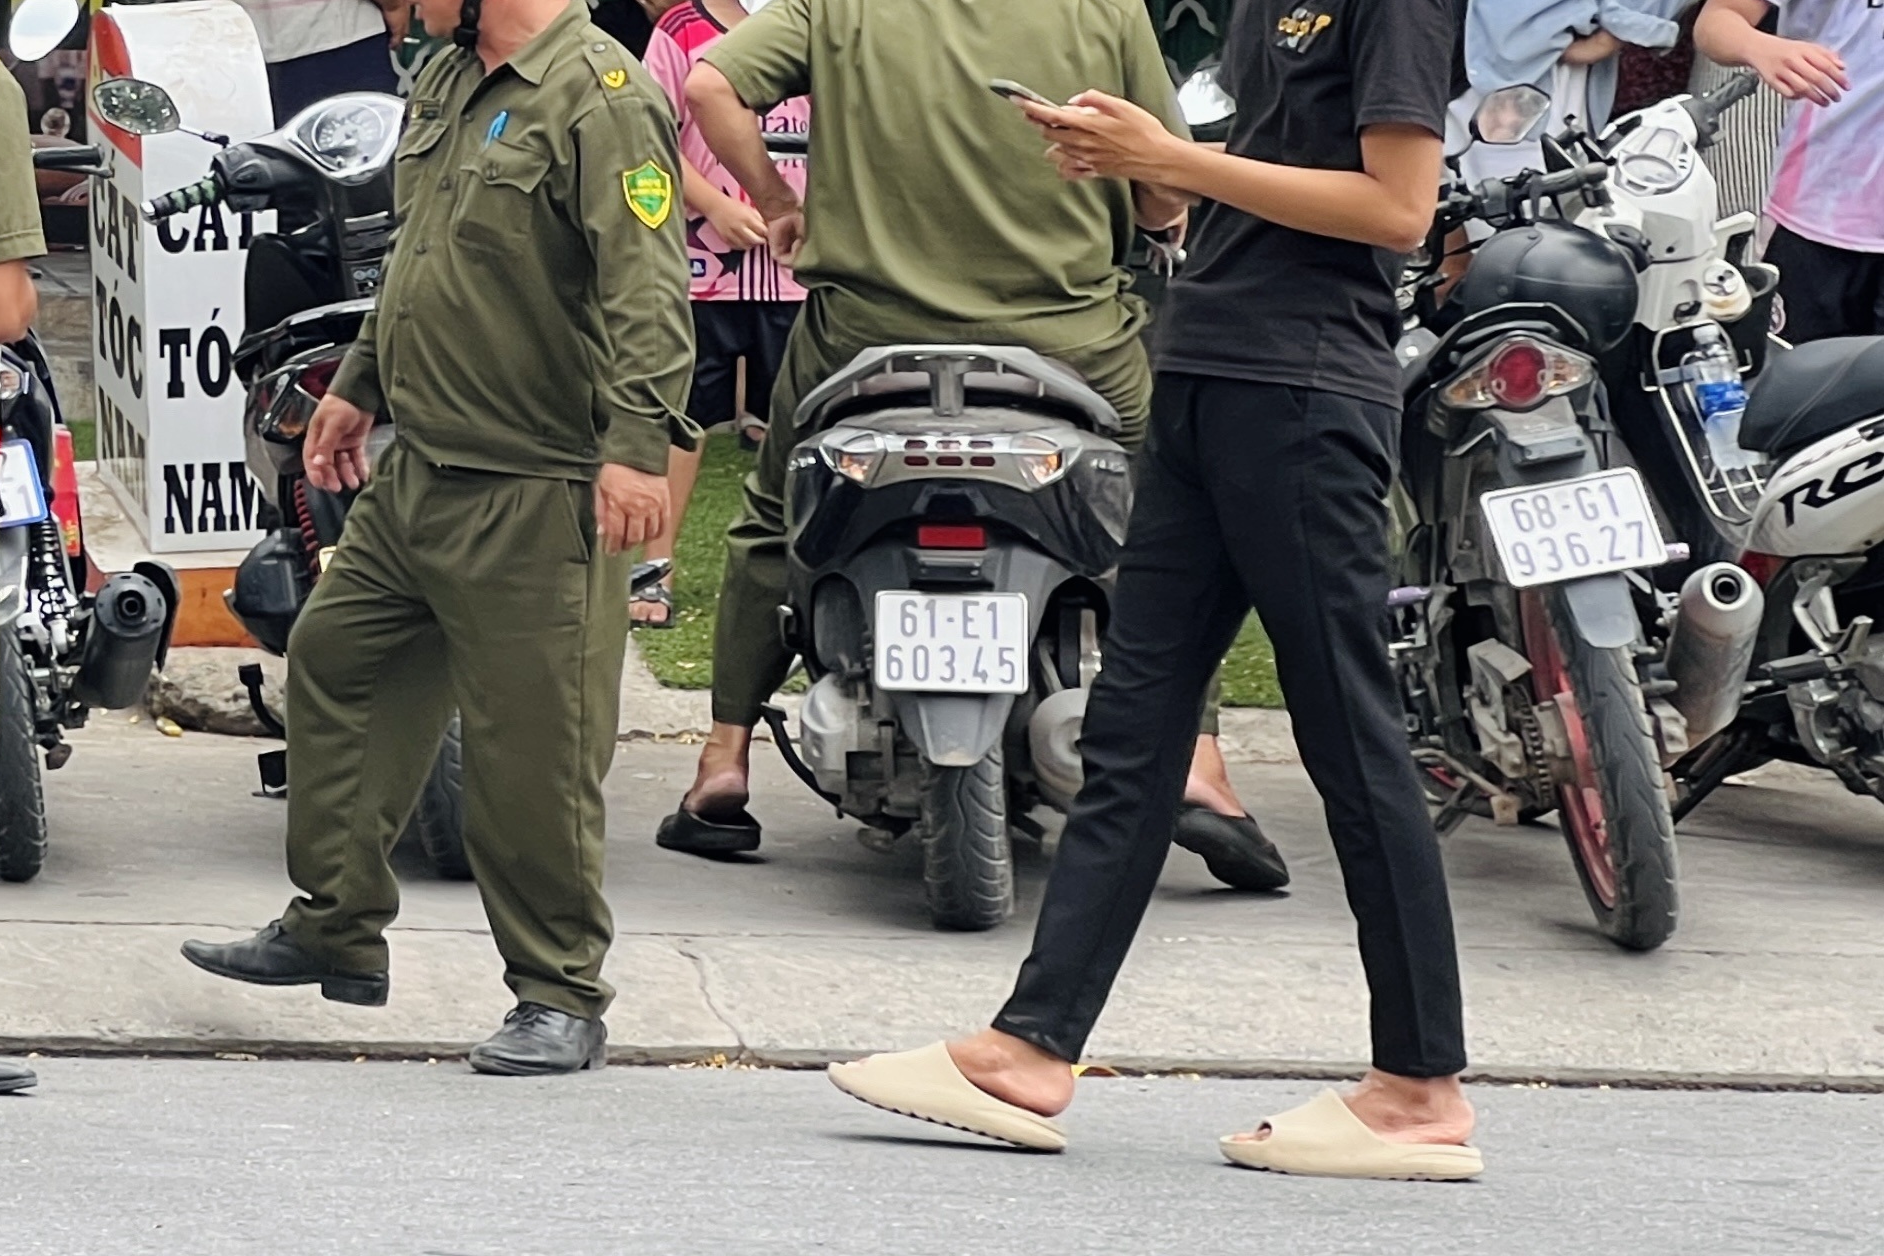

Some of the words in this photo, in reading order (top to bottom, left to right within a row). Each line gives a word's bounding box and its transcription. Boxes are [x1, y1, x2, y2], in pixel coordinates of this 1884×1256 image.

[96, 279, 143, 400] TÓC
[159, 307, 232, 399] TÓ
[163, 461, 268, 535] NAM
[1510, 482, 1620, 533] 68-G1
[1511, 520, 1644, 577] 936.27
[899, 599, 999, 640] 61-E1
[885, 644, 1016, 685] 603.45
